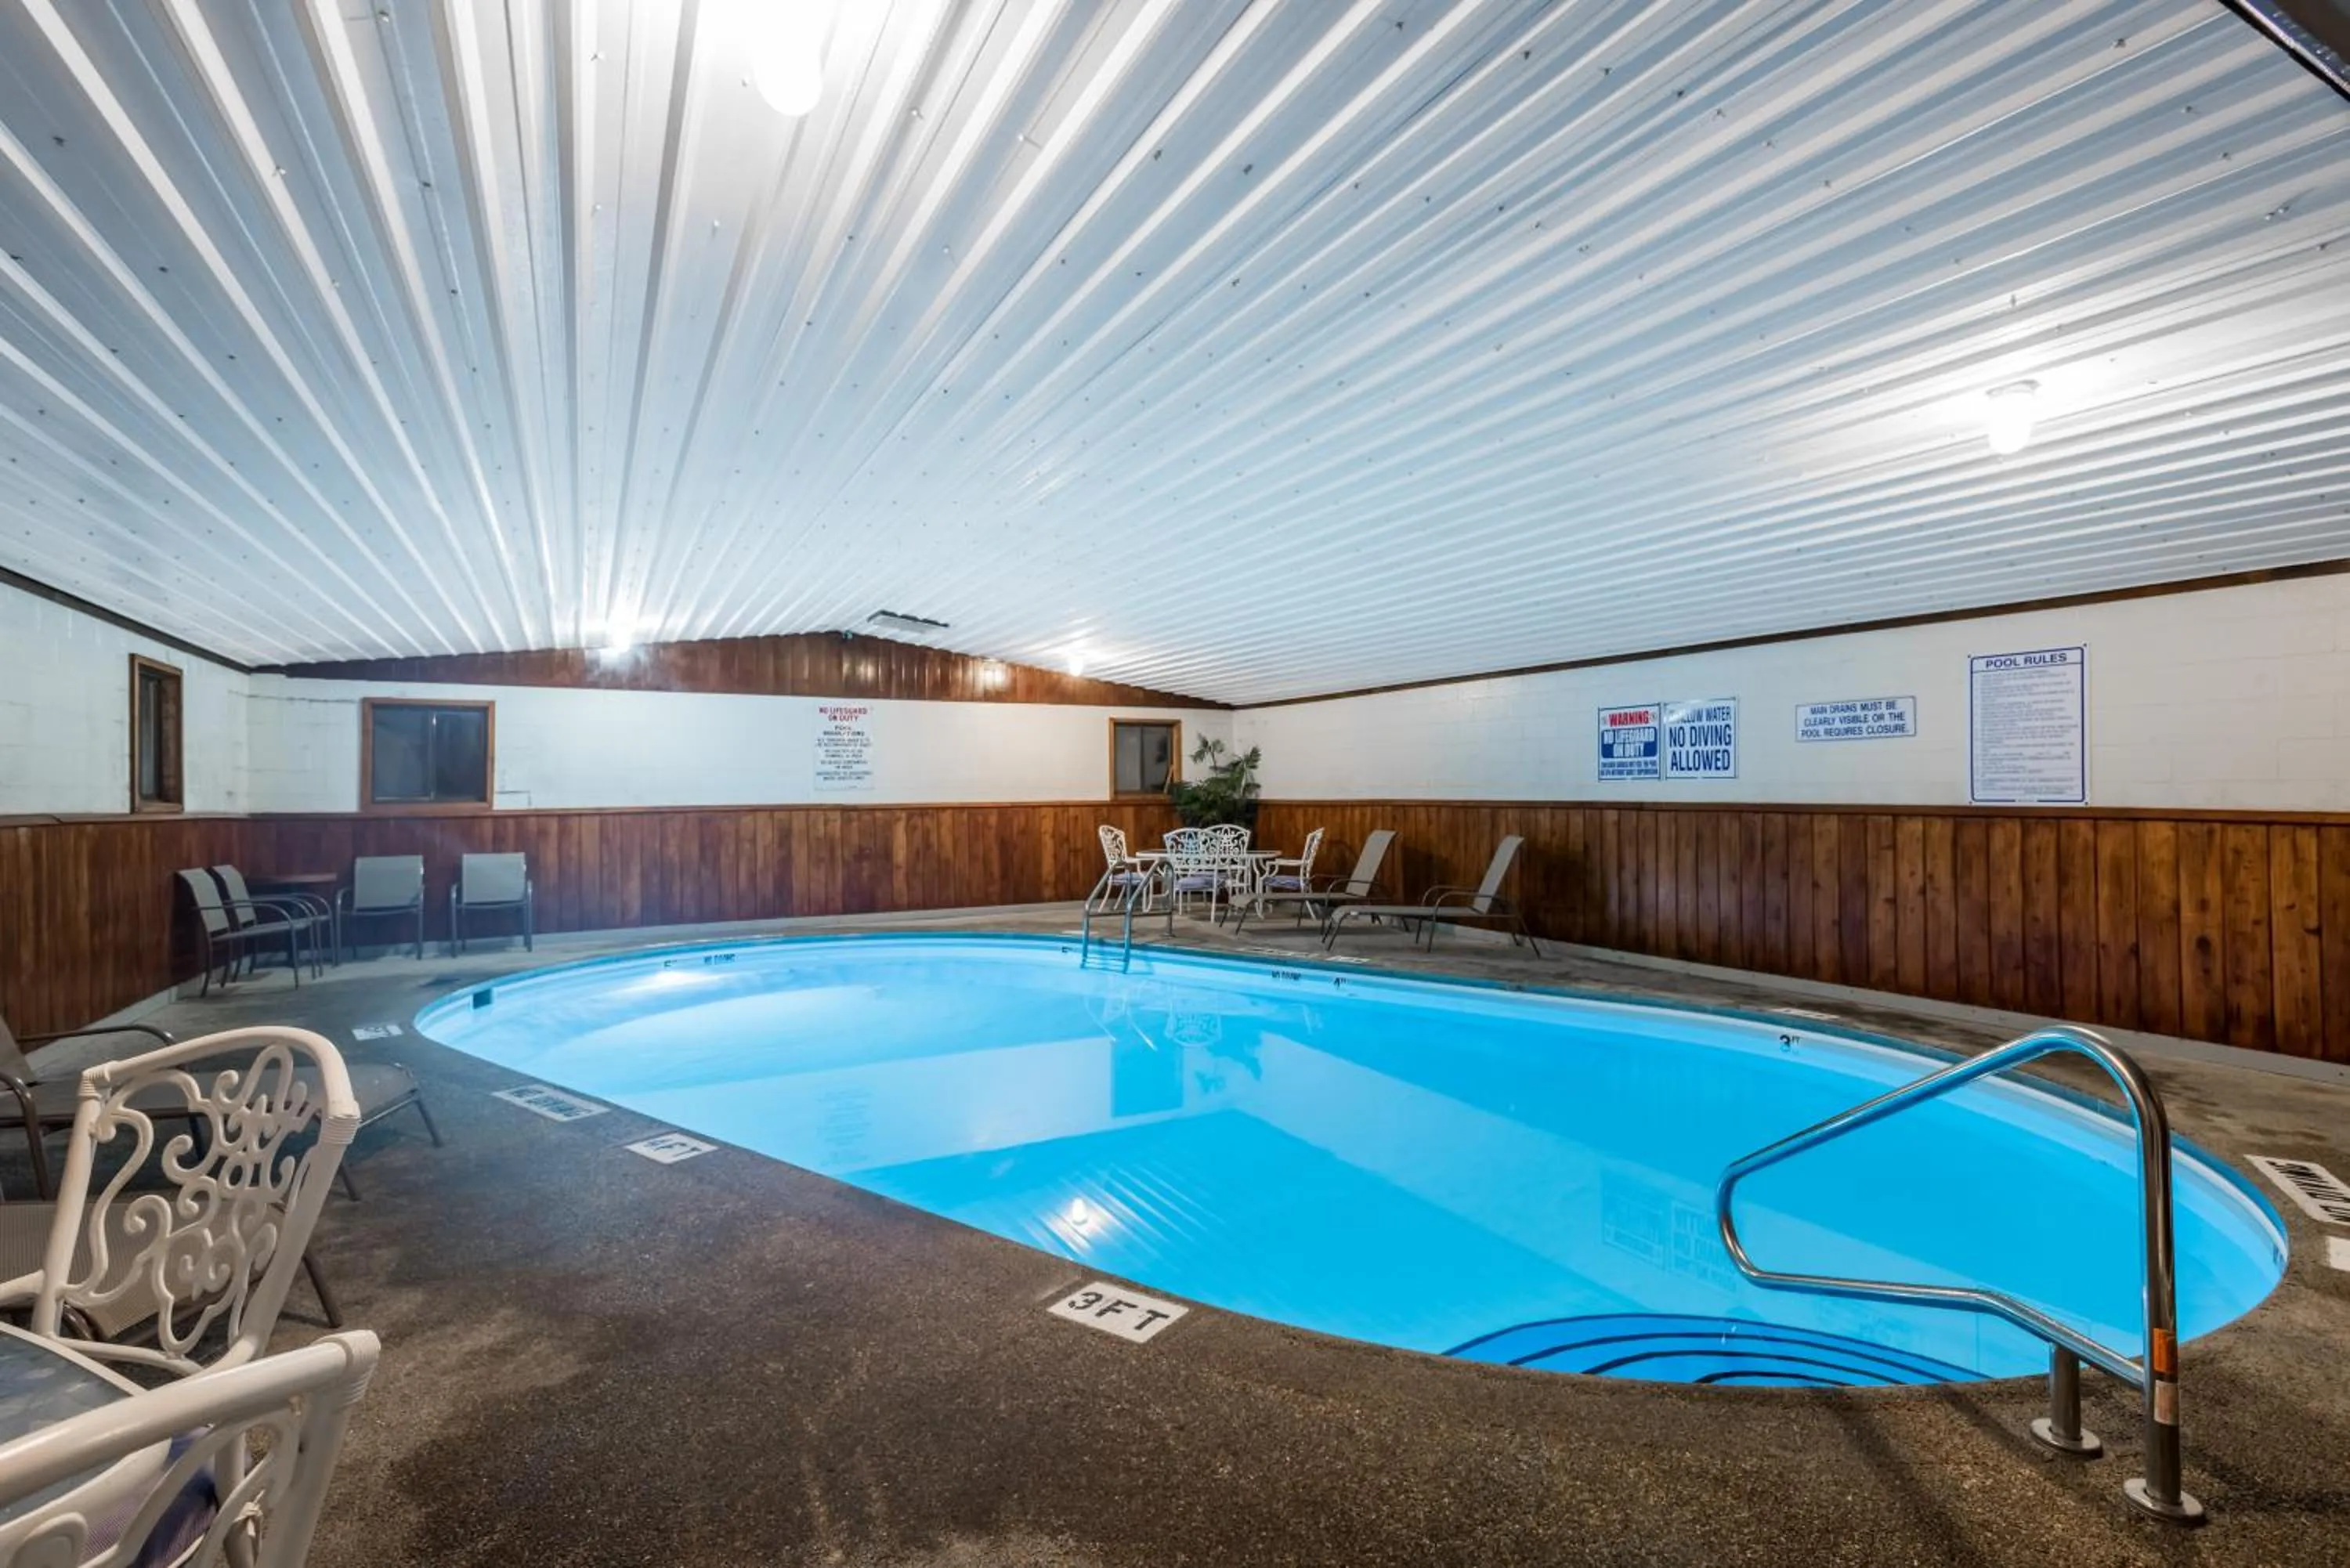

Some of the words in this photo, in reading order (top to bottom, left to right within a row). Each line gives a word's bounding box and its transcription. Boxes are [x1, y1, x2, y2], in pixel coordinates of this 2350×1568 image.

[1985, 658, 2020, 669] POOL
[2023, 653, 2067, 665] RULES
[1706, 706, 1731, 721] WATER
[1830, 704, 1857, 714] DRAINS
[1860, 701, 1882, 711] MUST
[1885, 700, 1896, 710] BE
[1609, 710, 1649, 727] WARNING
[1804, 717, 1835, 727] CLEARLY
[1838, 714, 1868, 724] VISIBLE
[1871, 713, 1885, 722] OR
[1889, 711, 1905, 721] THE
[1669, 726, 1685, 748] NO
[1690, 724, 1732, 747] DIVING
[1801, 728, 1820, 738] POOL
[1824, 726, 1864, 737] REQUIRES
[1671, 749, 1730, 771] ALLOWED
[1068, 1292, 1170, 1331] 3FT
